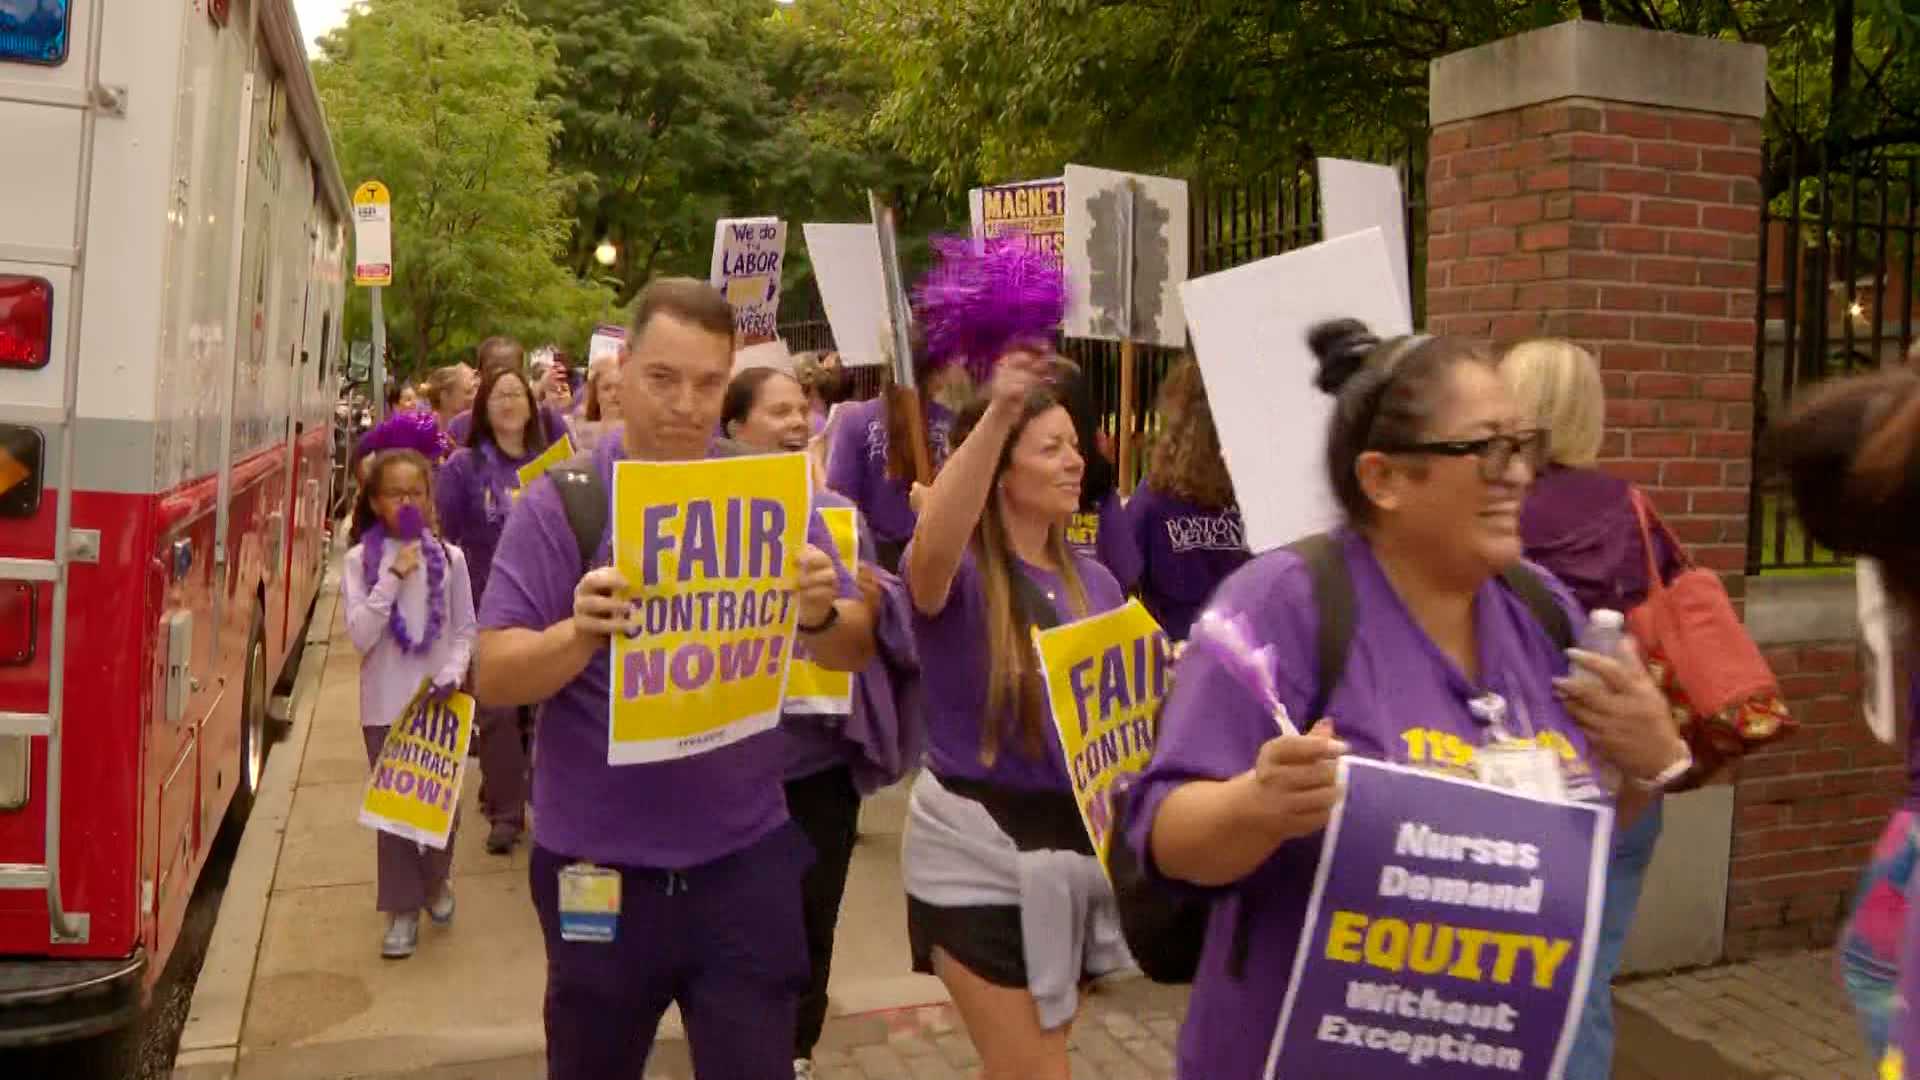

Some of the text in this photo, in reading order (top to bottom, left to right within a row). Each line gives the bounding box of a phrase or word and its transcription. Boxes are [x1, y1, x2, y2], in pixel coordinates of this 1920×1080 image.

[367, 188, 377, 200] T
[984, 186, 1064, 218] MAGNET
[732, 223, 777, 241] We do
[722, 251, 778, 276] LABOR
[642, 496, 785, 586] FAIR
[623, 588, 793, 639] CONTRACT
[623, 635, 785, 700] NOW!
[1074, 718, 1153, 792] CONTR
[376, 767, 452, 812] NOW!
[1394, 822, 1540, 869] Nurses
[1378, 865, 1544, 914] Demand
[1324, 911, 1572, 989] EQUITY
[1345, 981, 1518, 1032] Without
[1317, 1015, 1523, 1072] Exception
